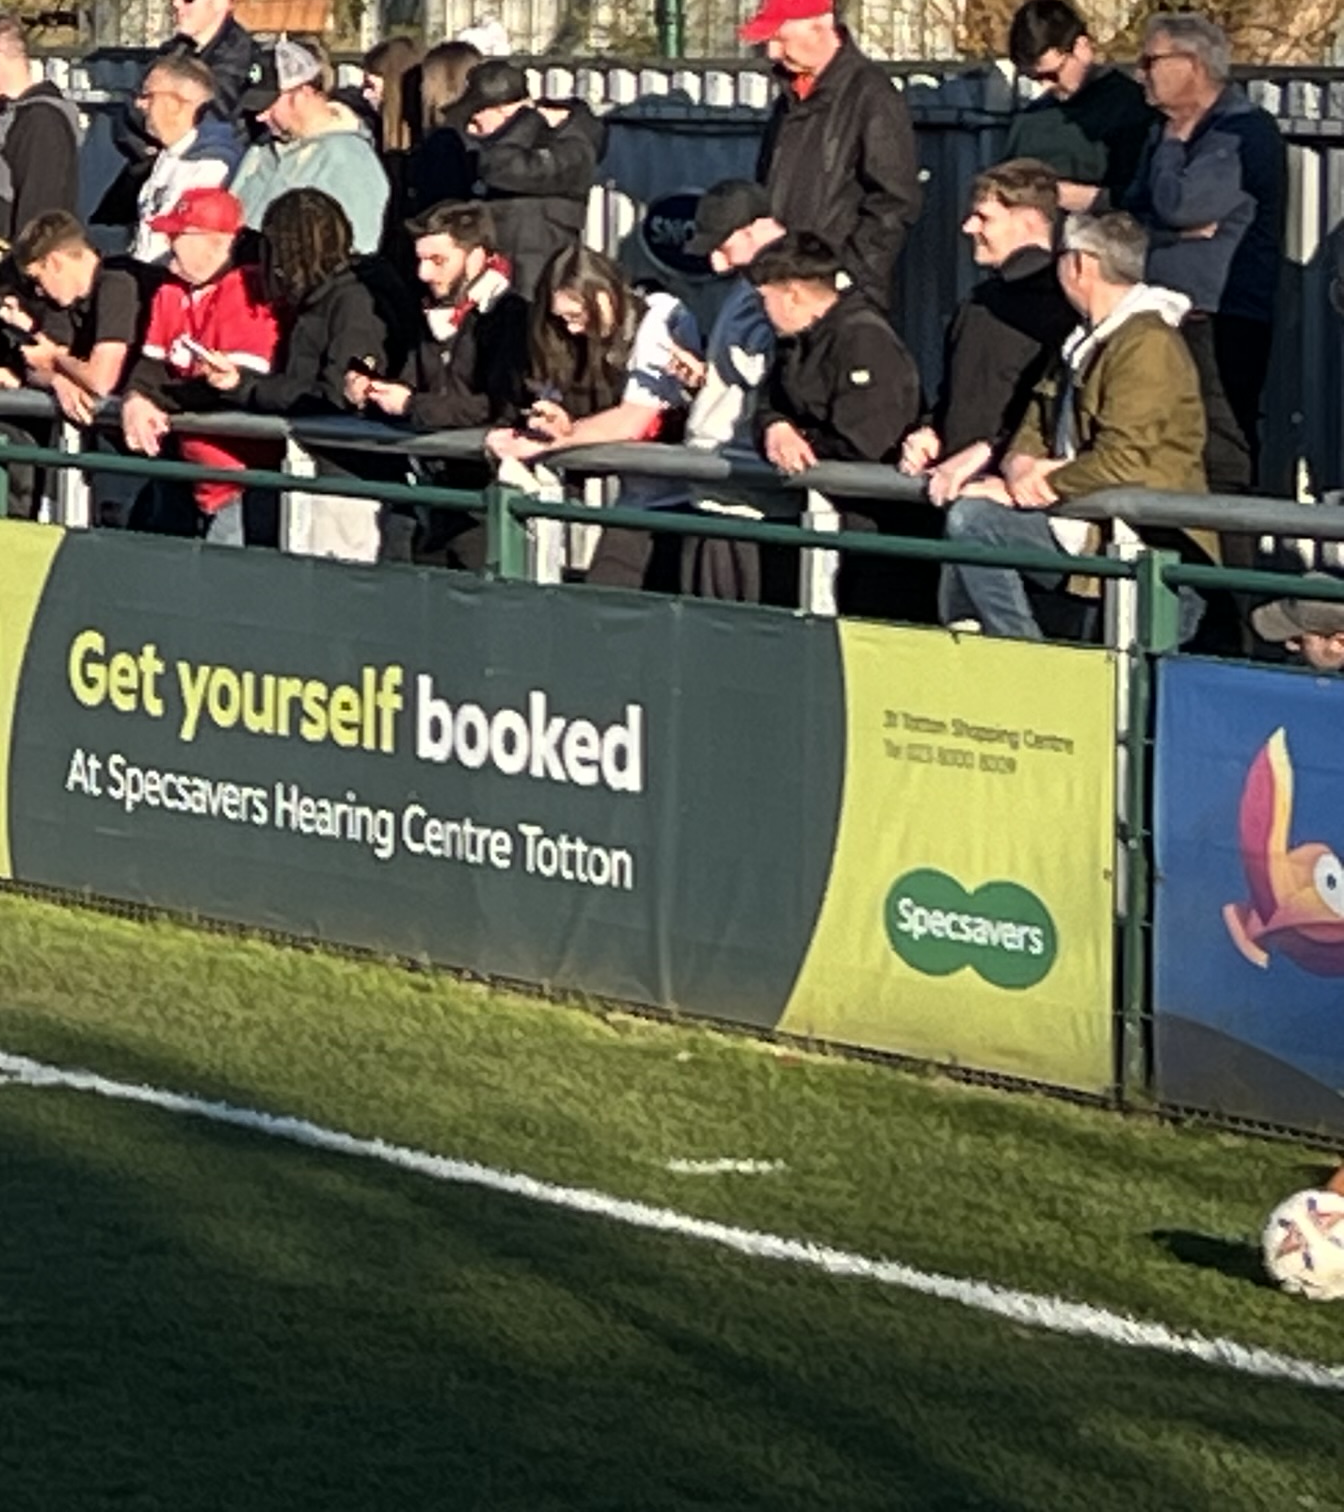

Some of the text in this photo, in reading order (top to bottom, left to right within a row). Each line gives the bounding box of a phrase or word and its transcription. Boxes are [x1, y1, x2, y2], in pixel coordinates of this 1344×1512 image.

[67, 629, 644, 793] Get yourself booked
[65, 748, 634, 890] At Specsavers Hearing Centre Totton
[896, 897, 1045, 955] Specsavers
